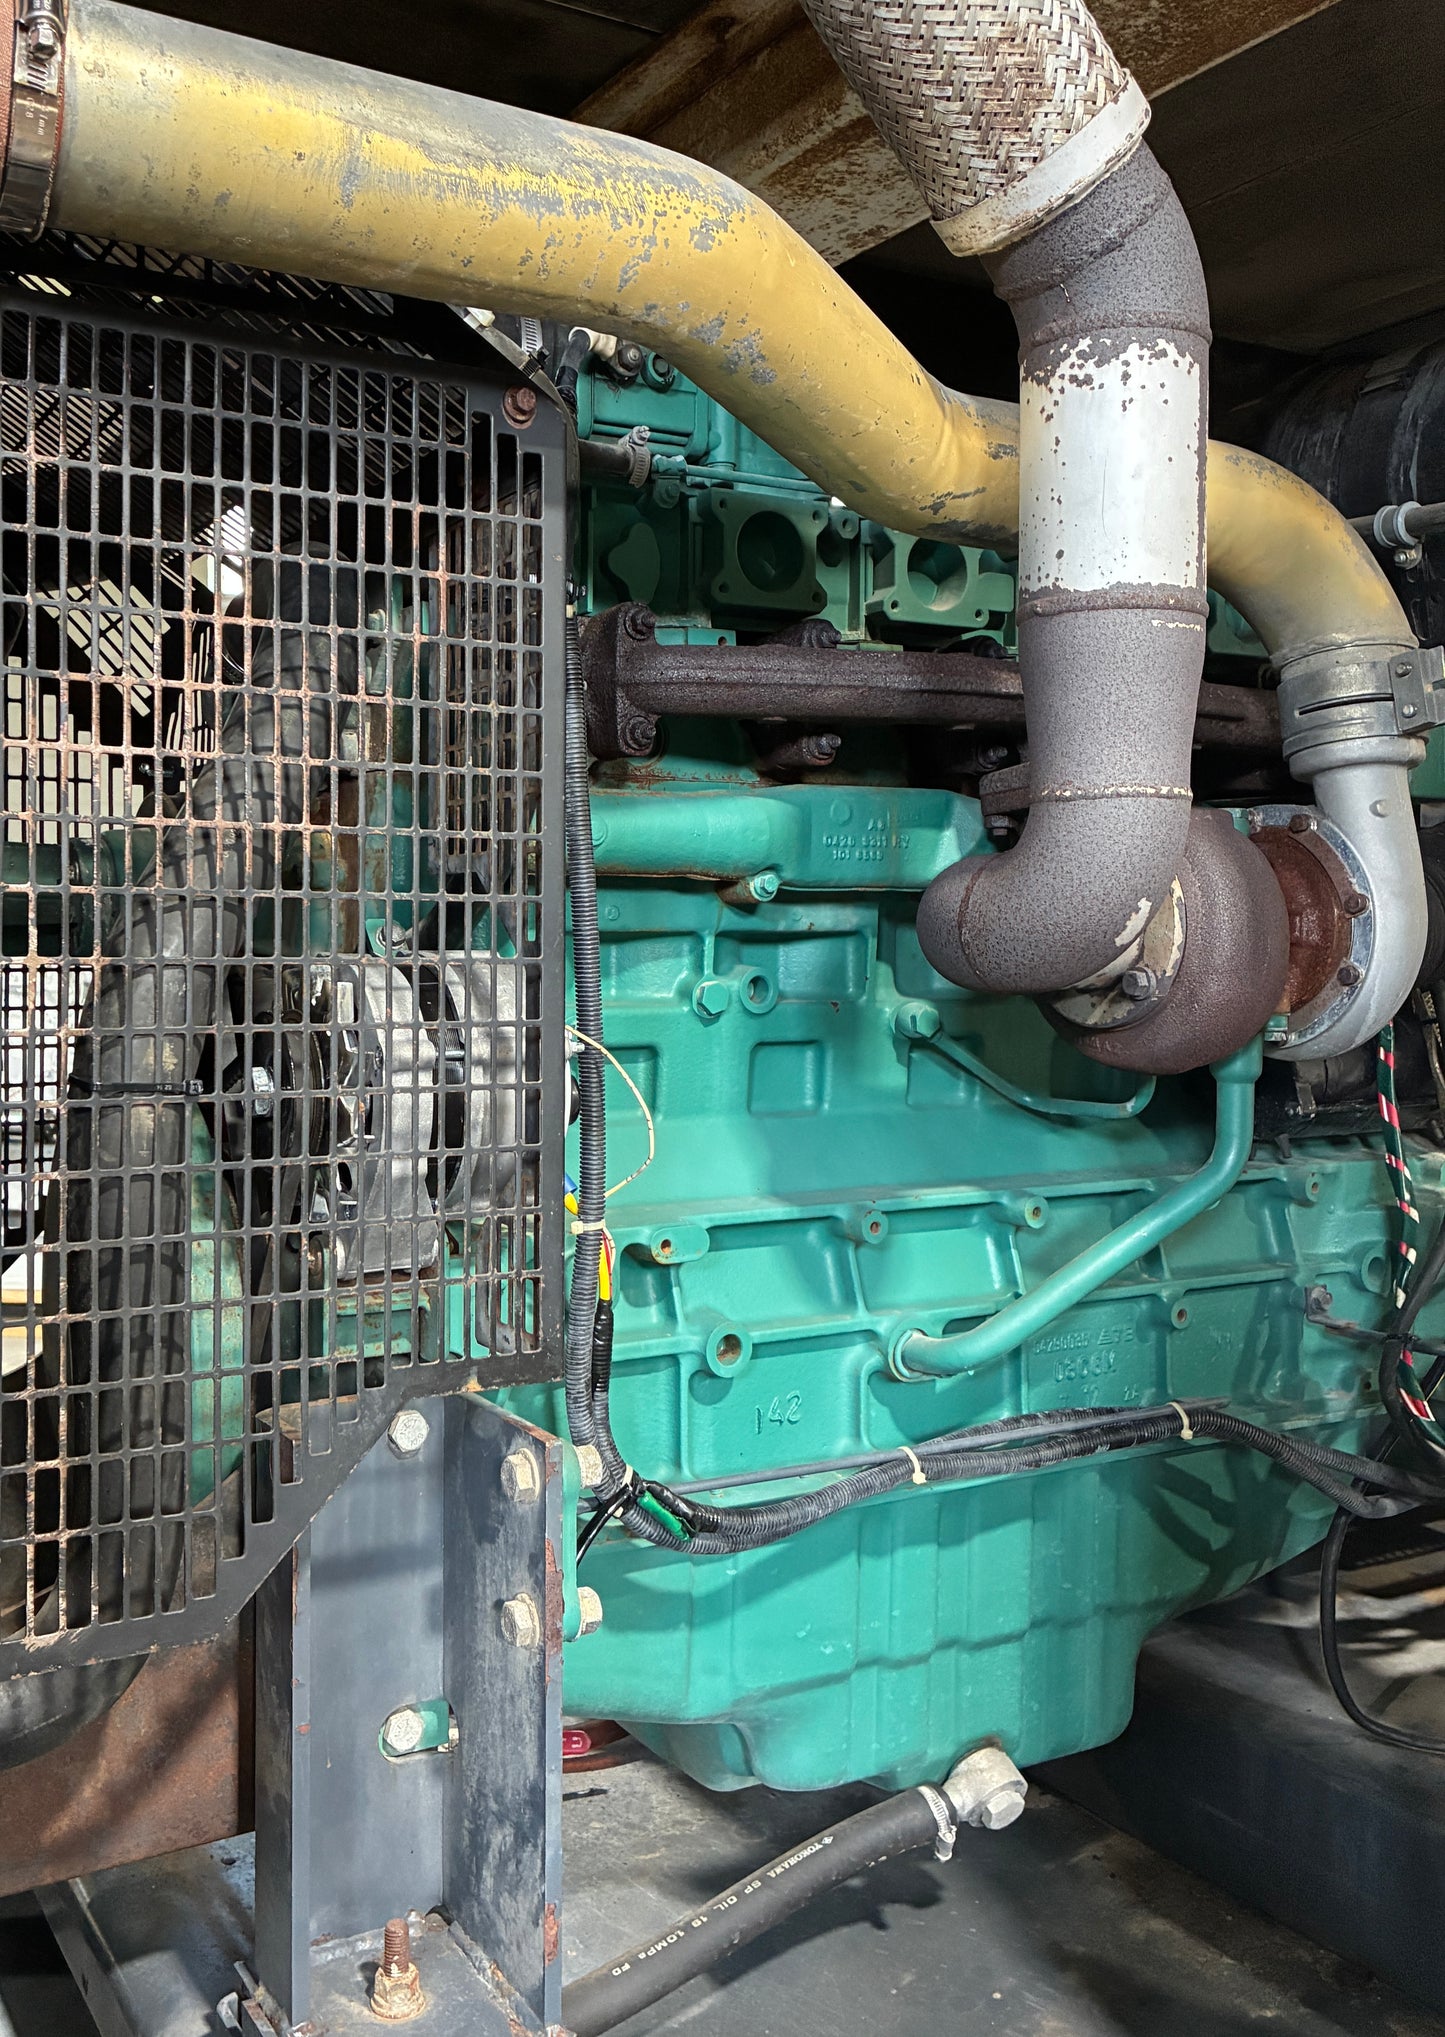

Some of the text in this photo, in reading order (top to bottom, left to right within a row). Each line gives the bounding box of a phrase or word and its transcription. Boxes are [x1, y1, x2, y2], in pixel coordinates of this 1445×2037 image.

[754, 1389, 802, 1435] 142
[766, 1842, 824, 1878] YOKOHAMA
[743, 1879, 762, 1895] SP
[712, 1895, 738, 1911] OIL
[611, 1962, 631, 1977] FD
